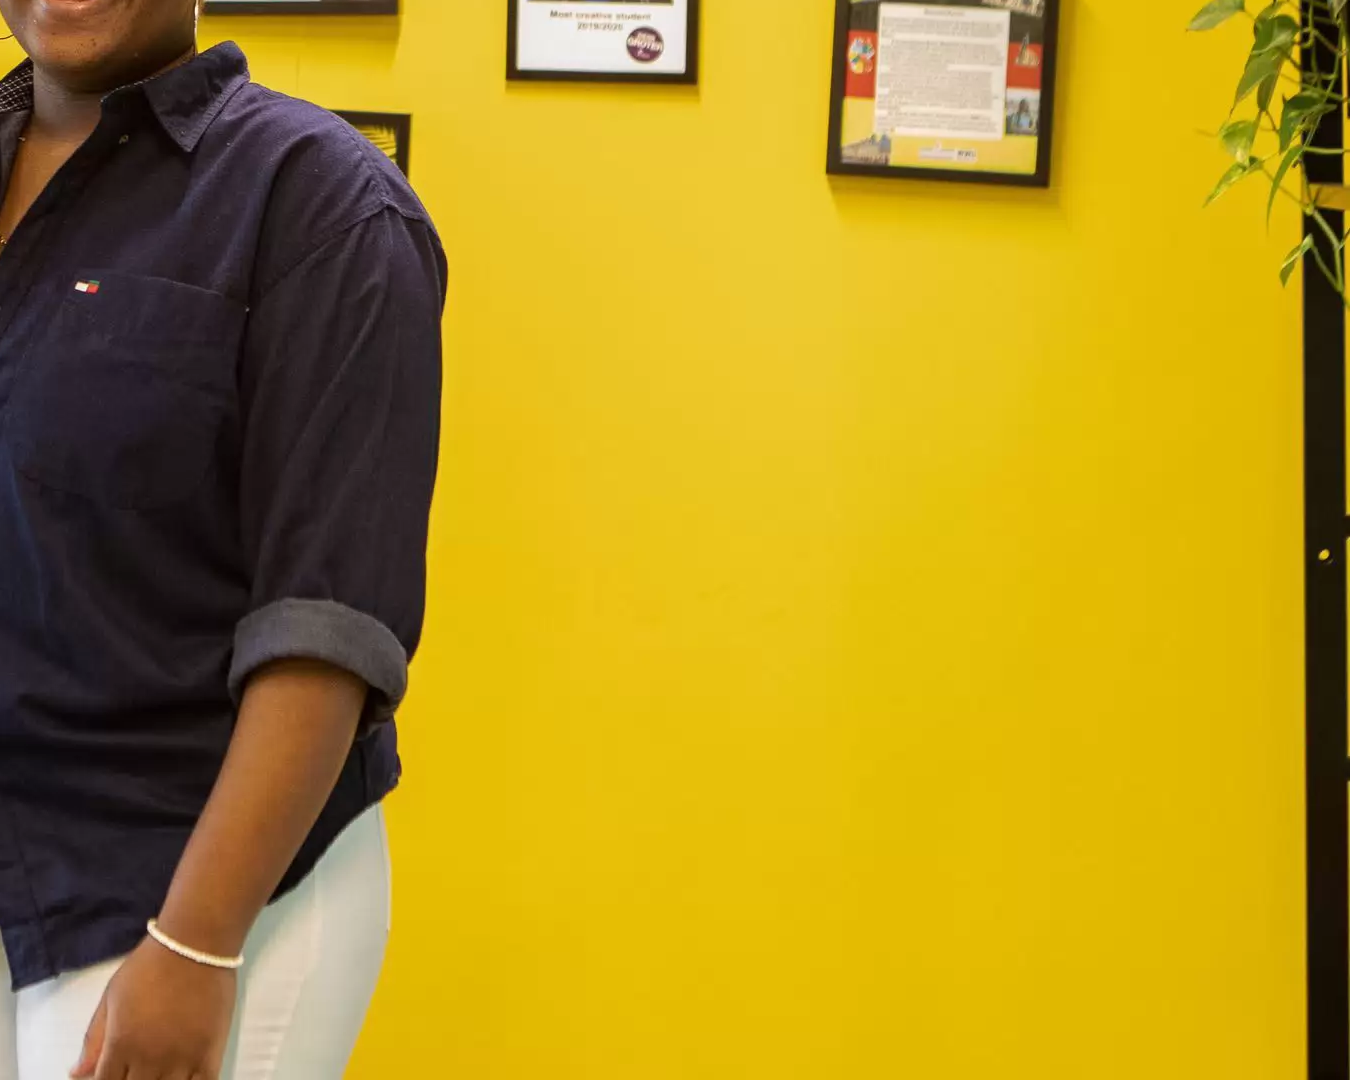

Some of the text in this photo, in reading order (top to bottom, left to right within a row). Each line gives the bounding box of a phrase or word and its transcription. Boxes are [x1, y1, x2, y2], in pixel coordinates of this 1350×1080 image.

[550, 9, 572, 18] Most
[576, 11, 612, 19] creative
[577, 22, 623, 31] 2019/2020
